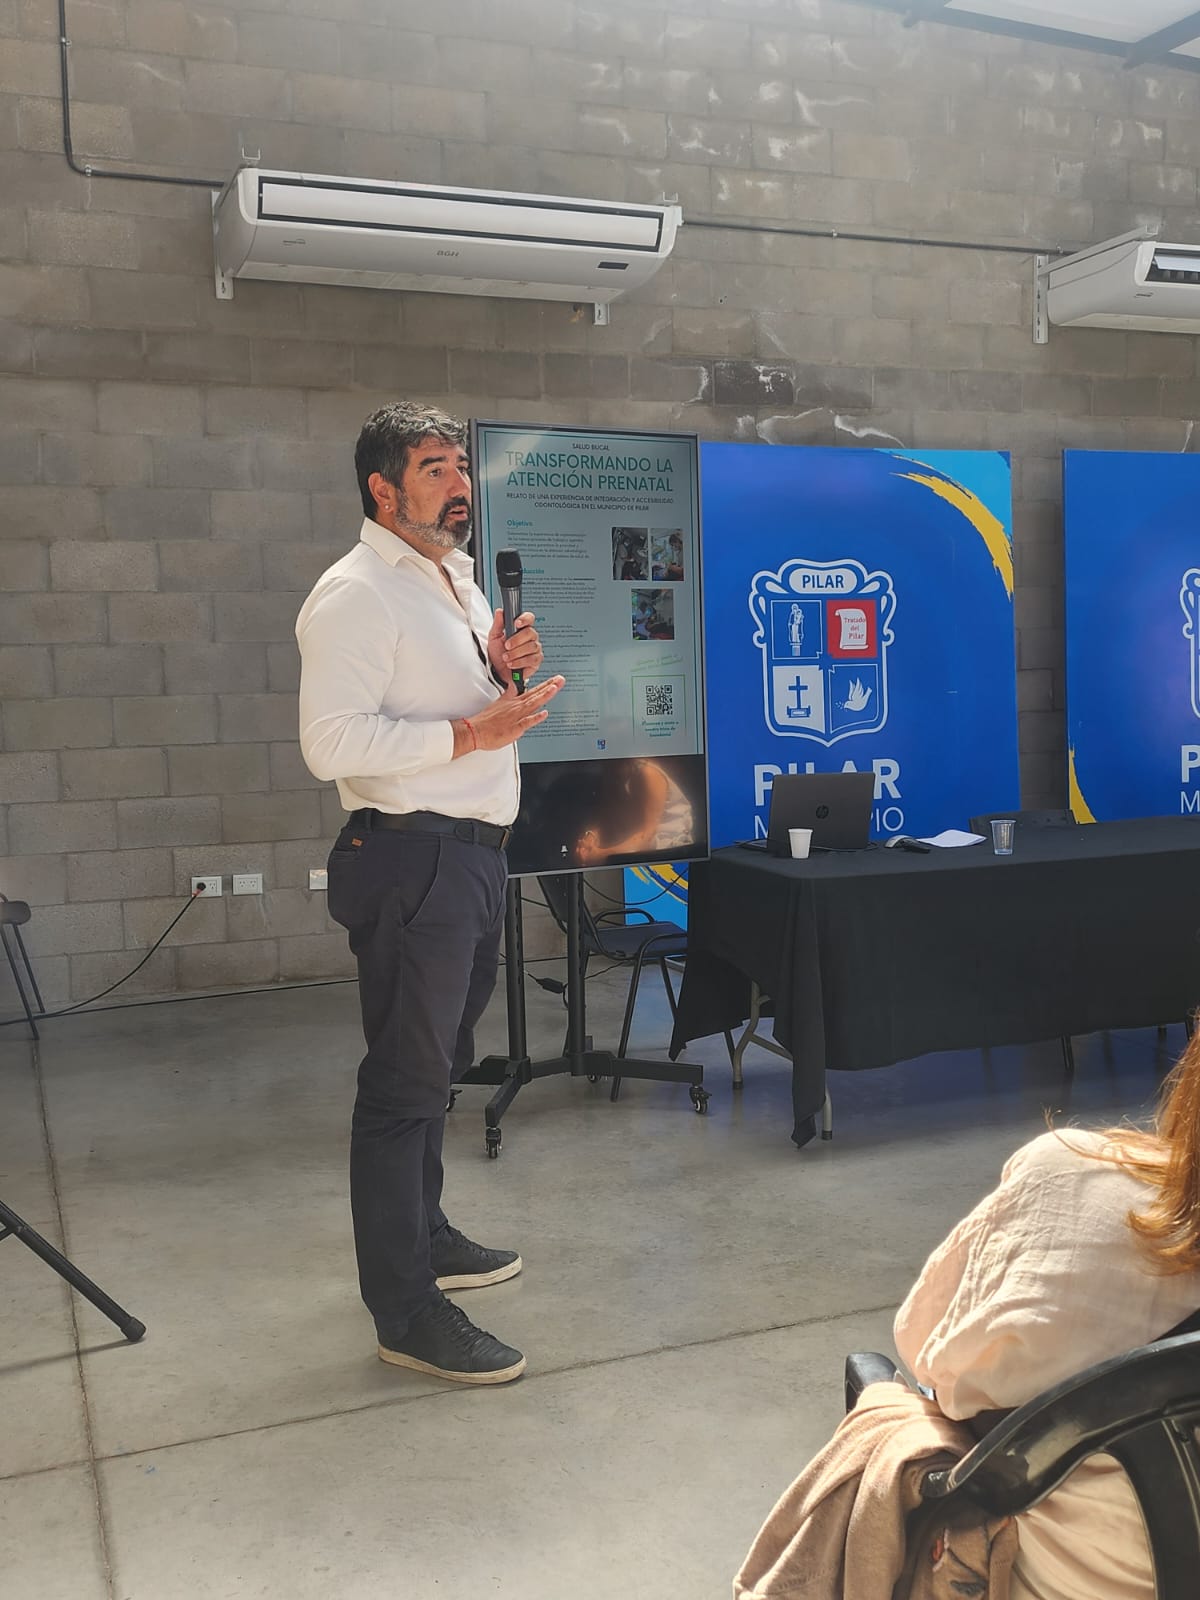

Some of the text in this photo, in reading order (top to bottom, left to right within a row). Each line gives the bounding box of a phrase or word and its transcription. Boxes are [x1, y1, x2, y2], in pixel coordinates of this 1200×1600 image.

[572, 442, 610, 451] SALUD BUCAL
[505, 450, 674, 473] TRANSFORMANDO LA
[506, 469, 673, 492] ATENCIÓN PRENATAL
[534, 501, 581, 509] ODONTOLÓGICA
[506, 519, 534, 528] Objetivo
[802, 574, 844, 589] PILAR
